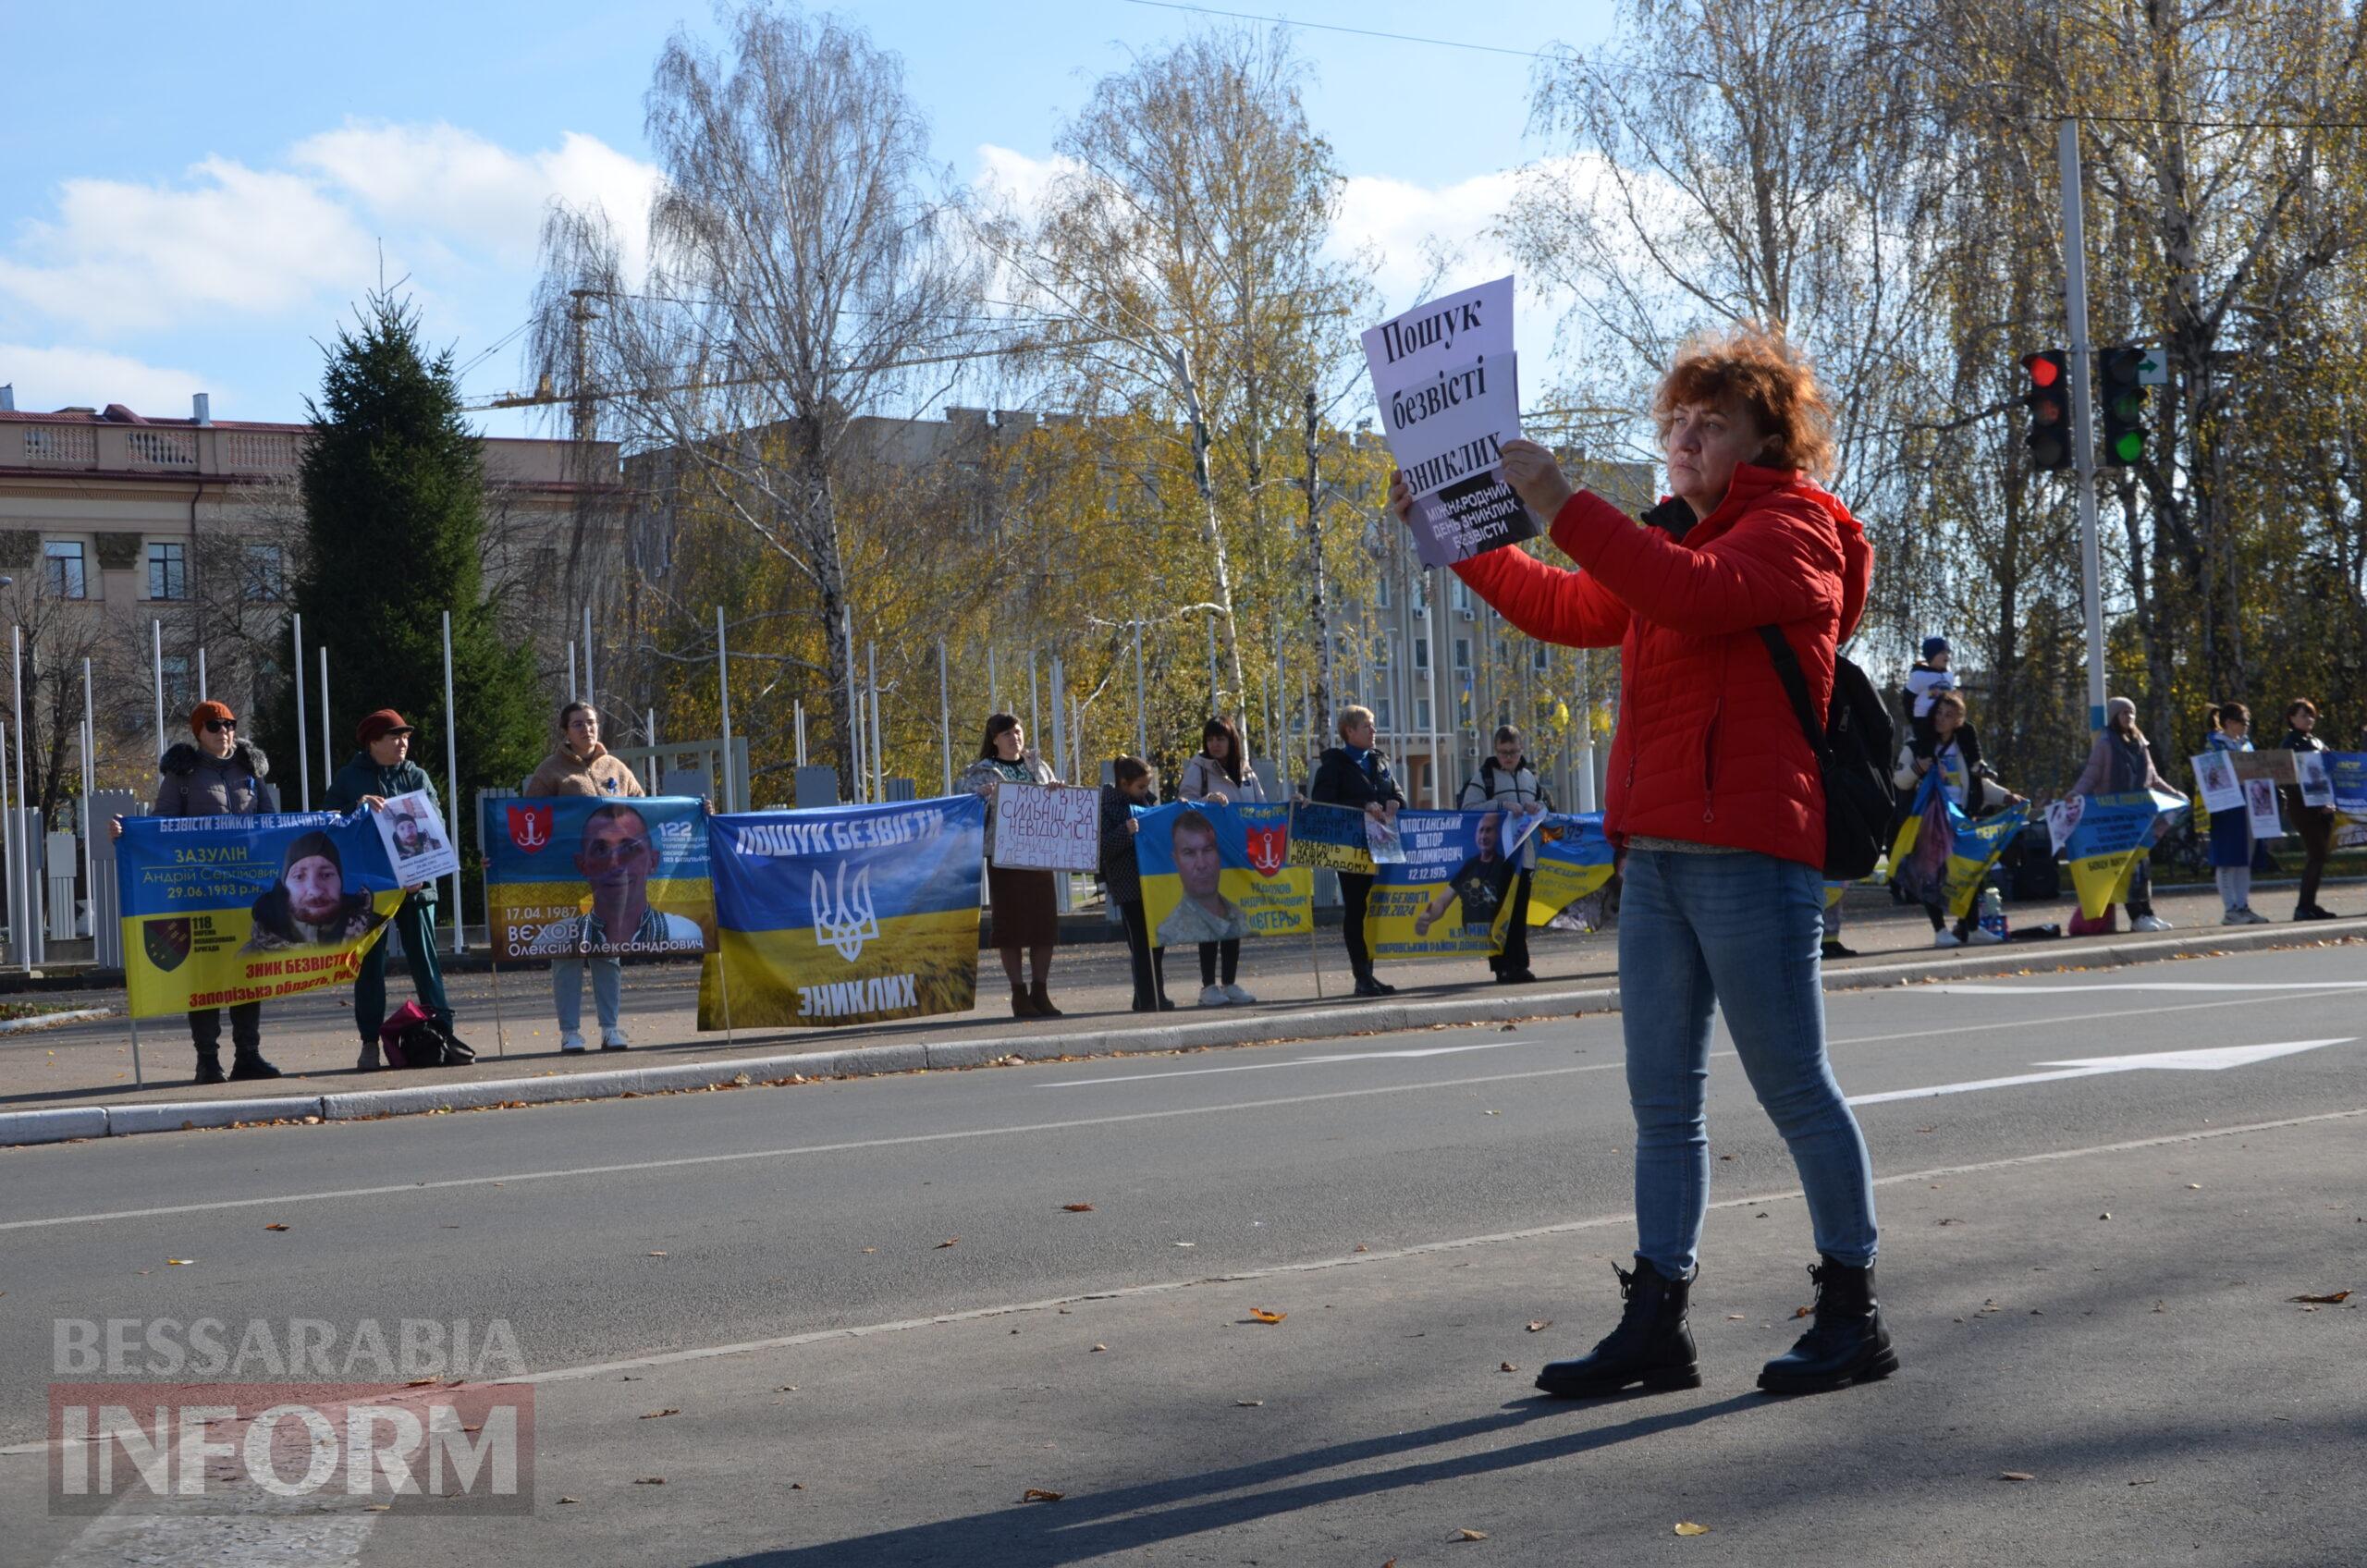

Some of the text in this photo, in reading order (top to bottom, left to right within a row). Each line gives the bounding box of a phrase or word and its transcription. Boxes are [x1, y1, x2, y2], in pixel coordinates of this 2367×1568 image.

[1380, 300, 1482, 365] Пошук
[1392, 354, 1487, 430] безвісті
[1425, 480, 1513, 524] МІЖНАРОДНИЙ
[1433, 496, 1520, 542] ДЕНЬ ЗНИКЛИХ
[1453, 521, 1509, 551] БЕЗВІСТИ
[1016, 786, 1095, 806] МОЯ ВІРА
[1000, 800, 1093, 823] СИЛЬНІШ ЗА
[160, 817, 215, 833] БЕЗВІСТИ
[261, 815, 276, 829] НЕ
[277, 814, 325, 828] ЗНАЧИТЬ
[657, 821, 693, 837] 122
[736, 808, 944, 856] ПОШУК БЕЗВІСТИ
[1416, 832, 1443, 849] ВІКТОР
[174, 846, 248, 864] ЗАЗУЛІН
[1404, 846, 1464, 865] ЛОДИМИРОВИЧ
[143, 866, 280, 884] Андрій Сергійович
[1324, 860, 1368, 873] ДОДОМУ
[1408, 867, 1448, 881] 12.12.1975
[167, 884, 264, 900] 29.06.1993 р.н.
[1391, 889, 1430, 903] БЕЗВІСТИ
[191, 916, 213, 930] 118
[506, 906, 578, 921] 17.04.1987
[508, 923, 580, 943] ВЄХОВ
[509, 937, 705, 957] Олексій Олександрович
[246, 962, 283, 980] ЗНИК
[190, 986, 272, 1008] Запорізька
[276, 976, 330, 997] область,
[798, 974, 918, 1017] ЗНИКЛИХ
